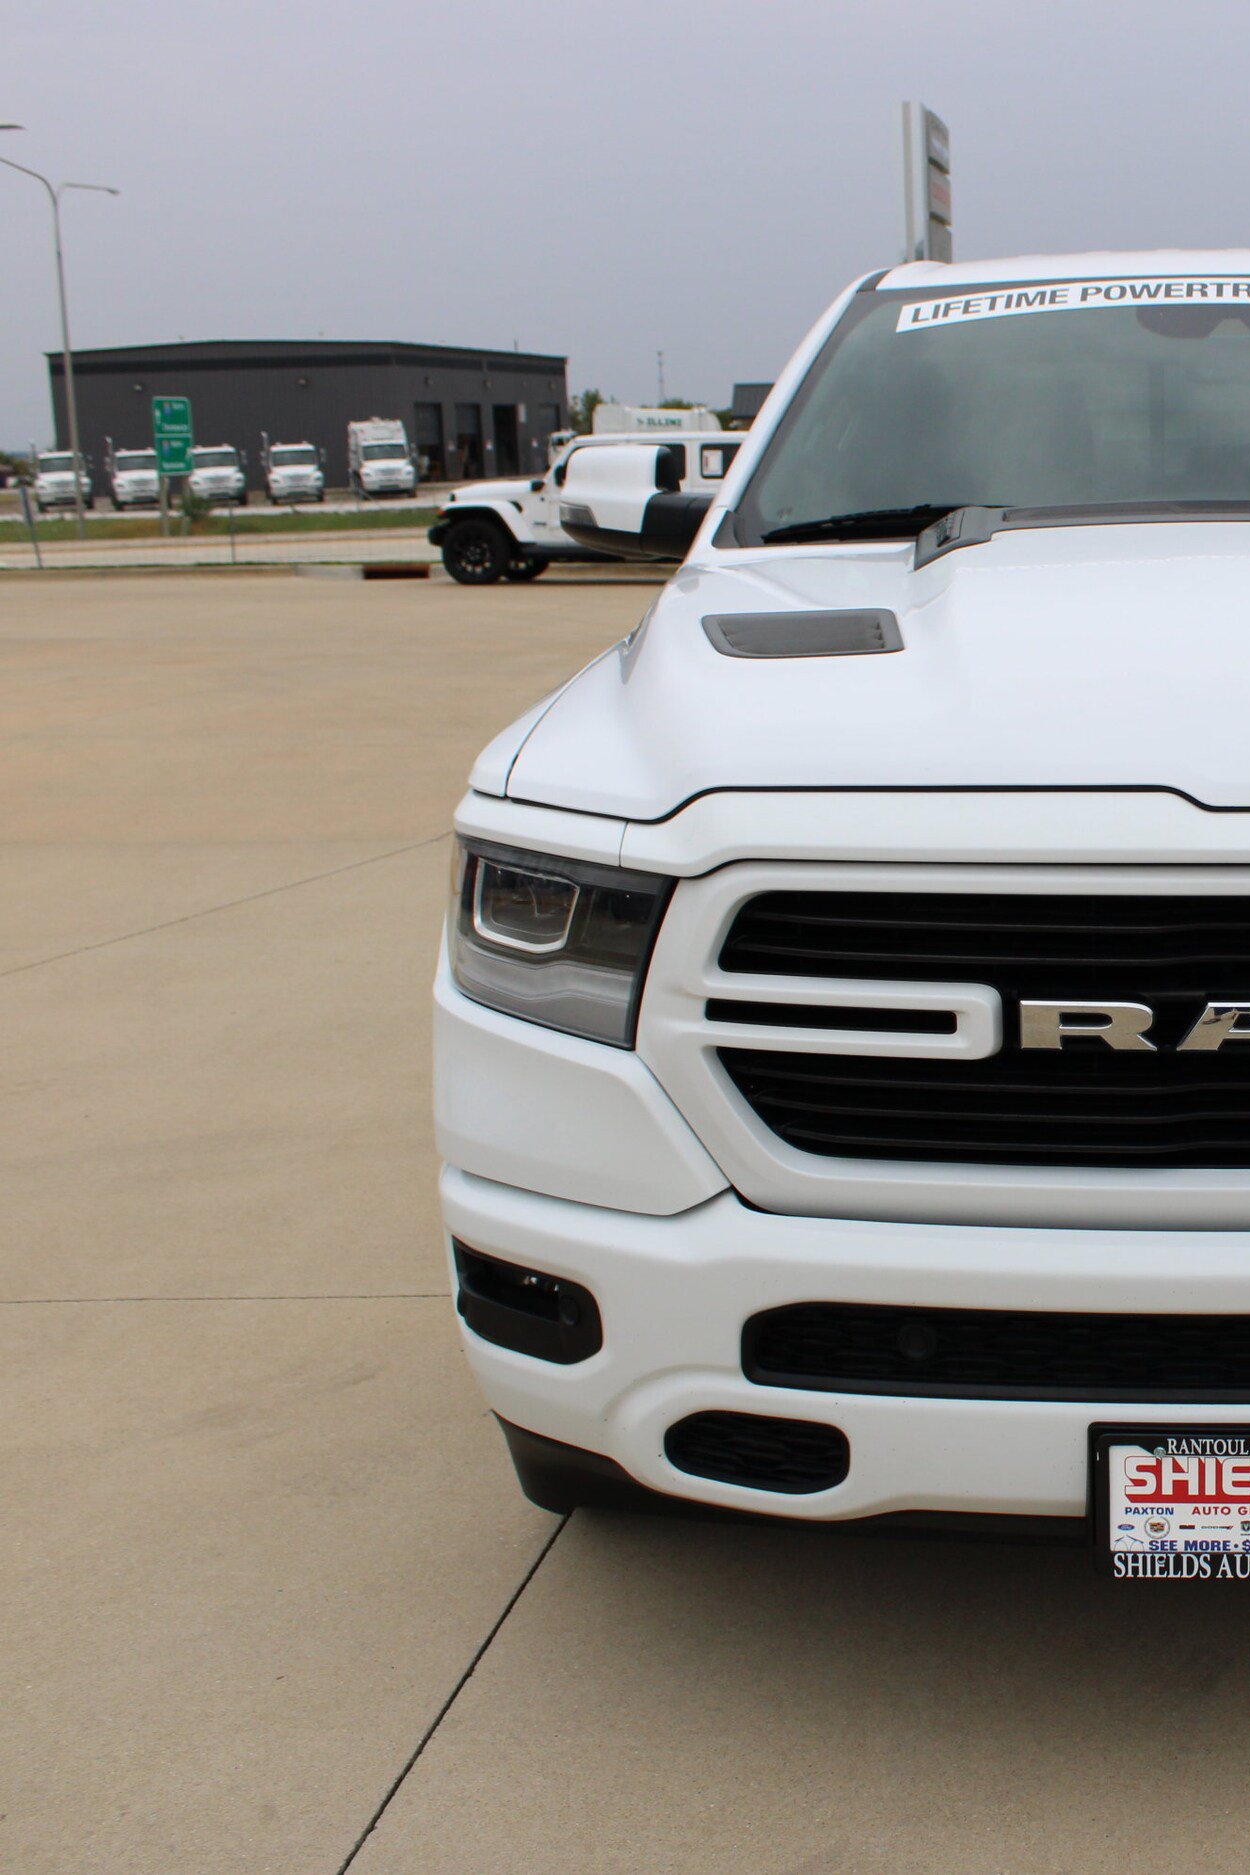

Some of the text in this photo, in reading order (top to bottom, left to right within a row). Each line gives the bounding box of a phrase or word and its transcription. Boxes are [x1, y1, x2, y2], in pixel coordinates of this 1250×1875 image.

[911, 289, 1069, 324] LIFETIME
[1166, 1438, 1249, 1456] RANTOUL
[1124, 1506, 1175, 1516] PAXTON
[1191, 1506, 1232, 1516] AUTO
[1148, 1540, 1178, 1552] SEE
[1184, 1540, 1232, 1552] MORE
[1113, 1552, 1212, 1579] SHIELDS
